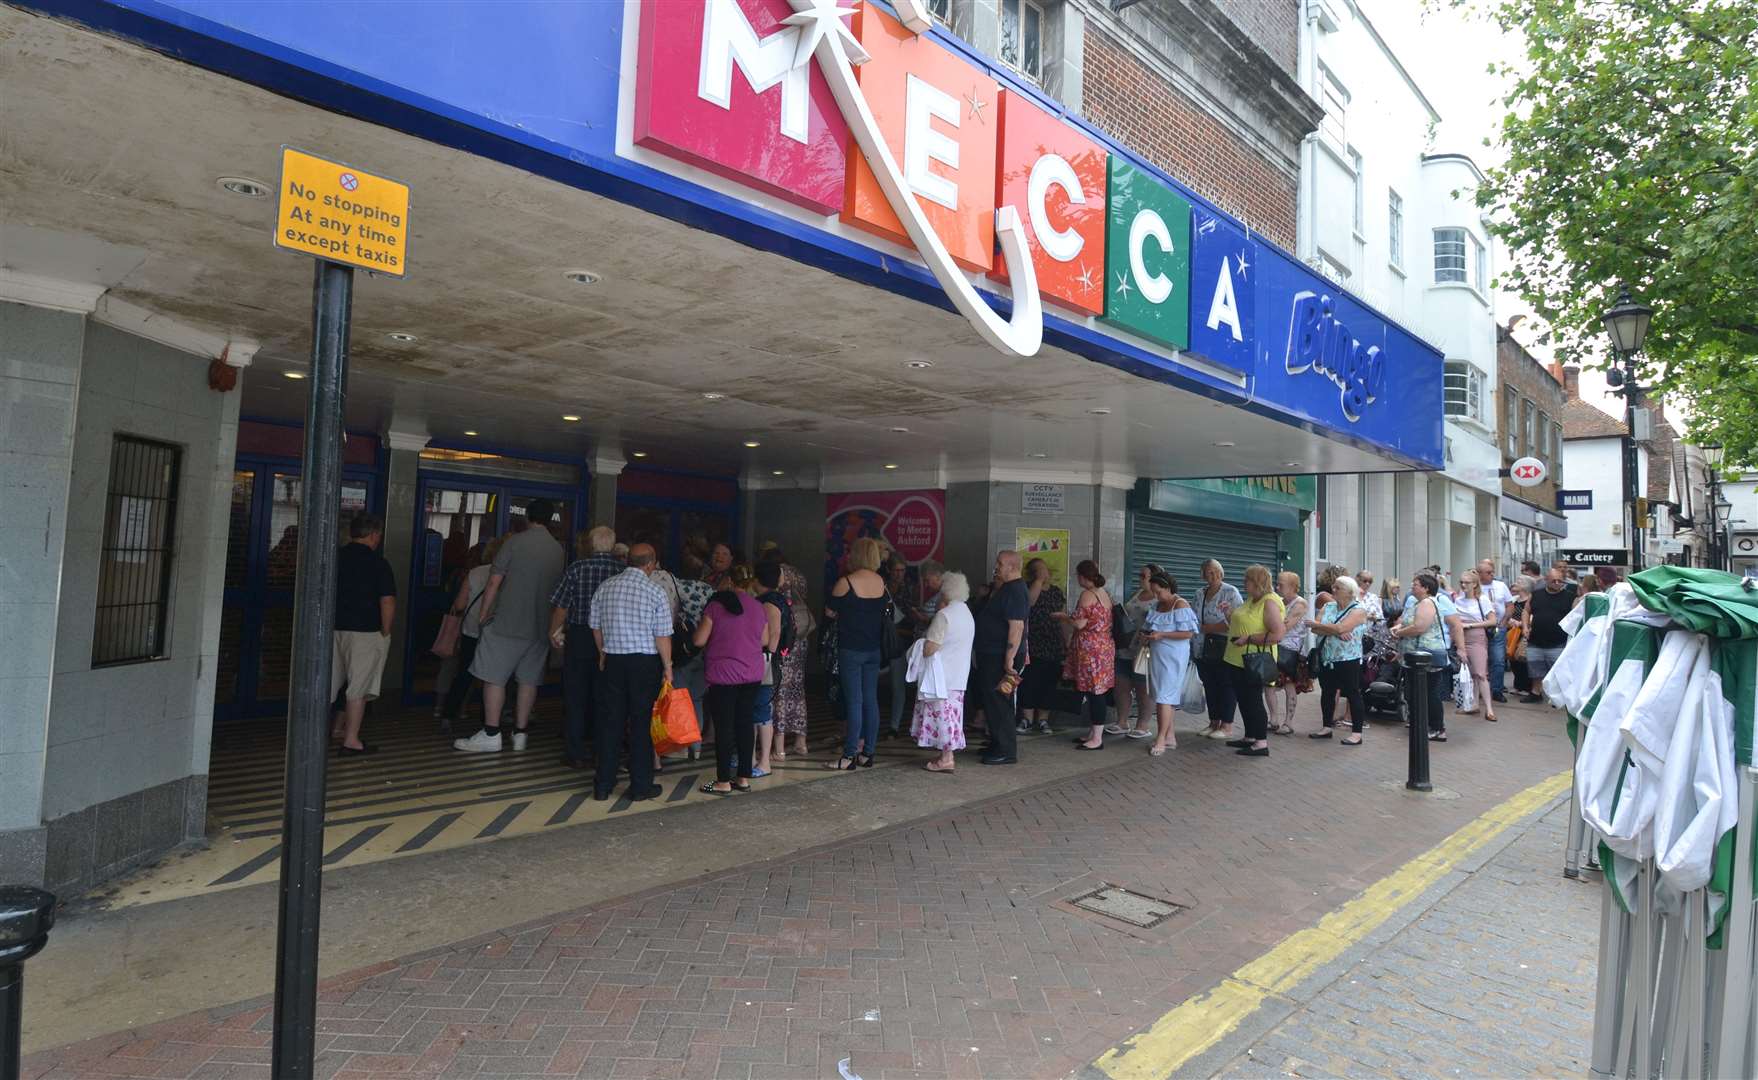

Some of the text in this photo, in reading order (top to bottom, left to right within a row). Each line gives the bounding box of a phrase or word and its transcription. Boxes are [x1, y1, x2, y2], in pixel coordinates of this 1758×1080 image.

[697, 0, 1244, 342] MECCA
[289, 181, 401, 228] No stopping
[289, 205, 397, 246] At any time
[285, 228, 398, 266] except taxis
[1286, 290, 1387, 422] Bingo
[1564, 495, 1589, 506] MANN
[897, 517, 931, 525] Welcome
[897, 527, 931, 535] to Mecca
[897, 535, 931, 545] Ashford
[1575, 553, 1614, 563] Carvery
